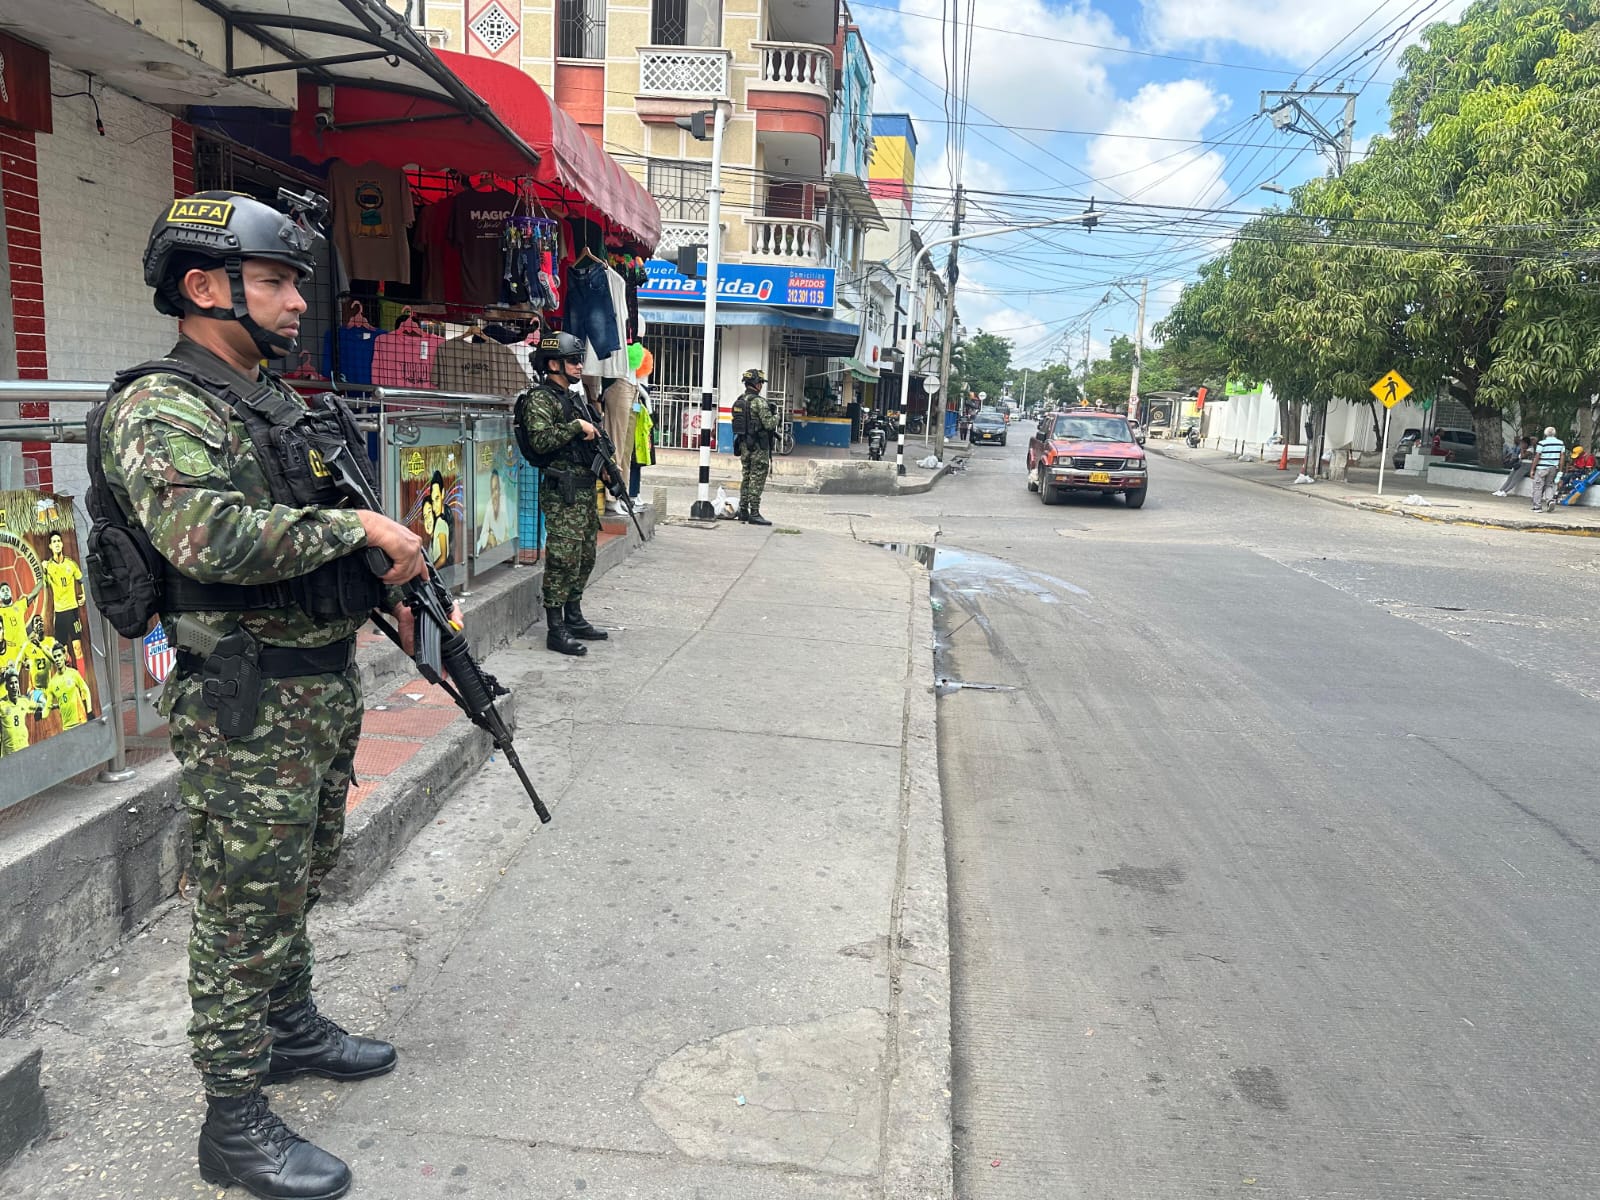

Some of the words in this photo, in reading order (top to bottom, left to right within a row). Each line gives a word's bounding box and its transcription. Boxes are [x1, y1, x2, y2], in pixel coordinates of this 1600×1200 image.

[175, 204, 222, 219] ALFA
[470, 210, 511, 220] MAGIC
[37, 658, 46, 670] 23
[62, 692, 68, 703] 6
[14, 715, 19, 727] 8
